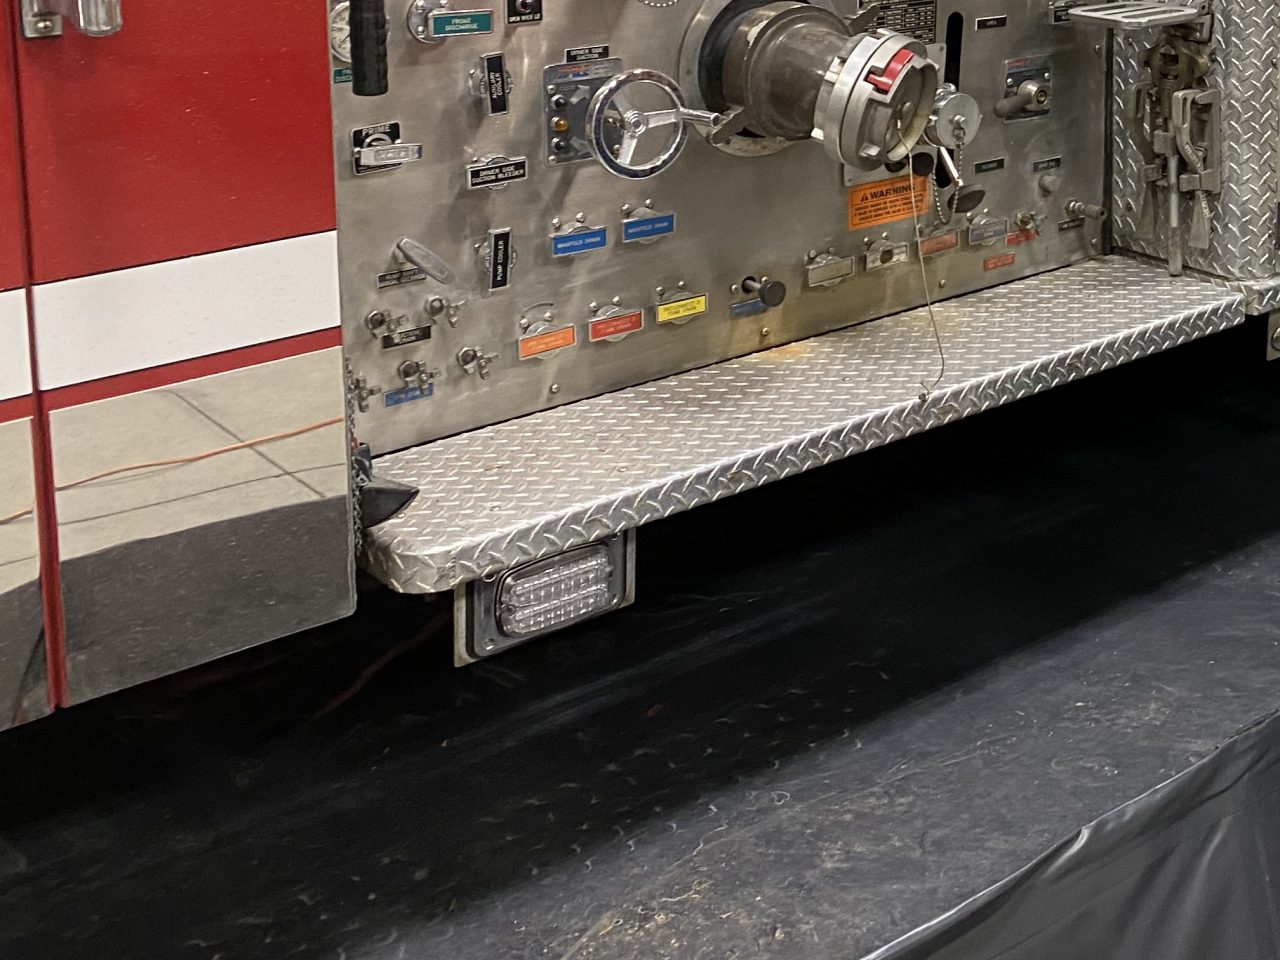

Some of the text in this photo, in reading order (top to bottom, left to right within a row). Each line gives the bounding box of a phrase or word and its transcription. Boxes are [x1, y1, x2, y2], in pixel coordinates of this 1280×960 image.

[445, 23, 479, 32] DISCHARGE
[362, 124, 391, 136] PRIME
[472, 170, 524, 184] SUCTION BLEEDER
[870, 184, 916, 200] WARNING
